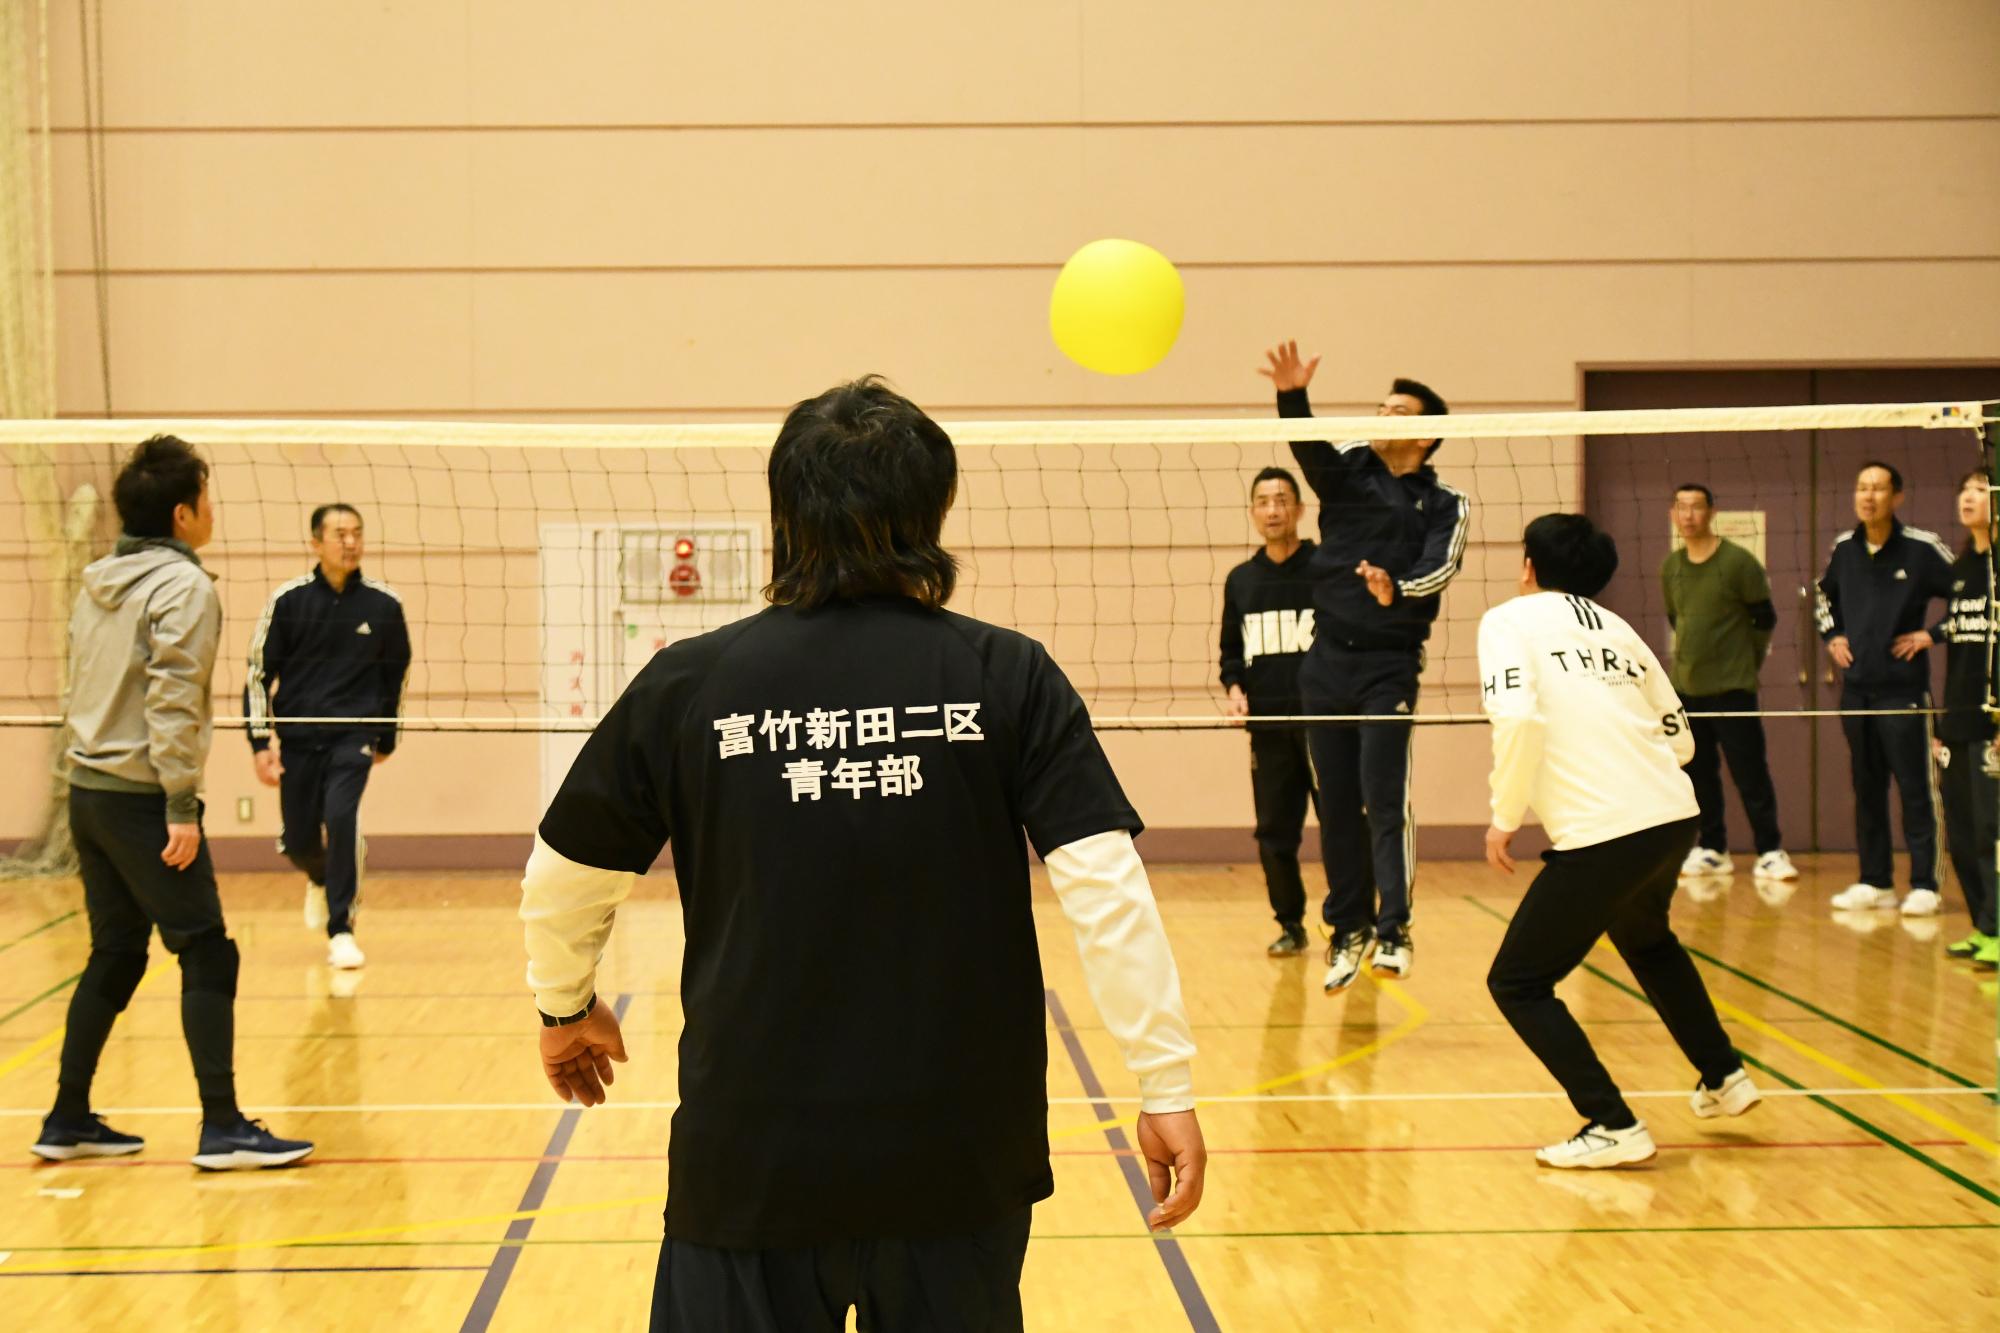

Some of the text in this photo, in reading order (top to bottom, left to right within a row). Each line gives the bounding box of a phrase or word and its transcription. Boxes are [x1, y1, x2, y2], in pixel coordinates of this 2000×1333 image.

[1241, 608, 1316, 667] NIK
[713, 702, 984, 760] 富竹新田二区
[781, 754, 924, 802] 青年部
